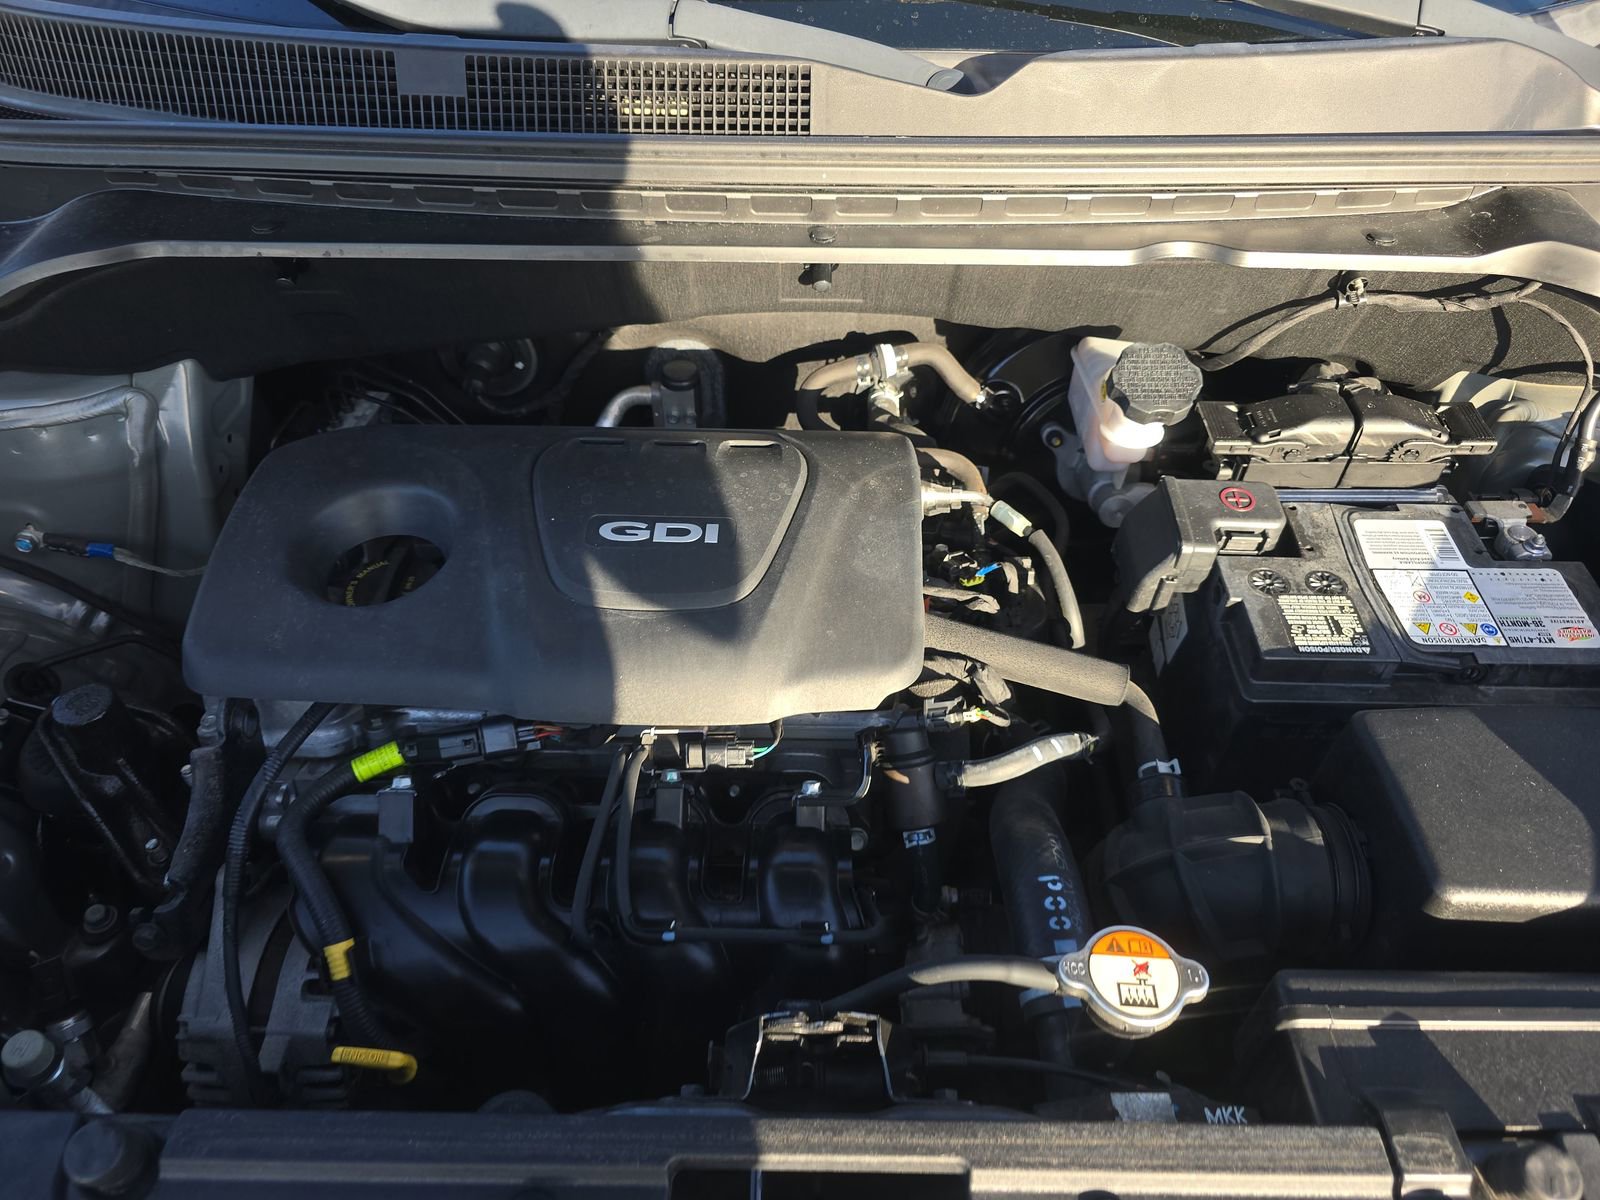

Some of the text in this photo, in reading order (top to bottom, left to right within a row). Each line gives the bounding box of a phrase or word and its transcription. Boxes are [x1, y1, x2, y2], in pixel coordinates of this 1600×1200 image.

[598, 521, 719, 543] GDI
[1063, 960, 1204, 983] HCC 1.1
[1203, 1105, 1248, 1124] MKK
